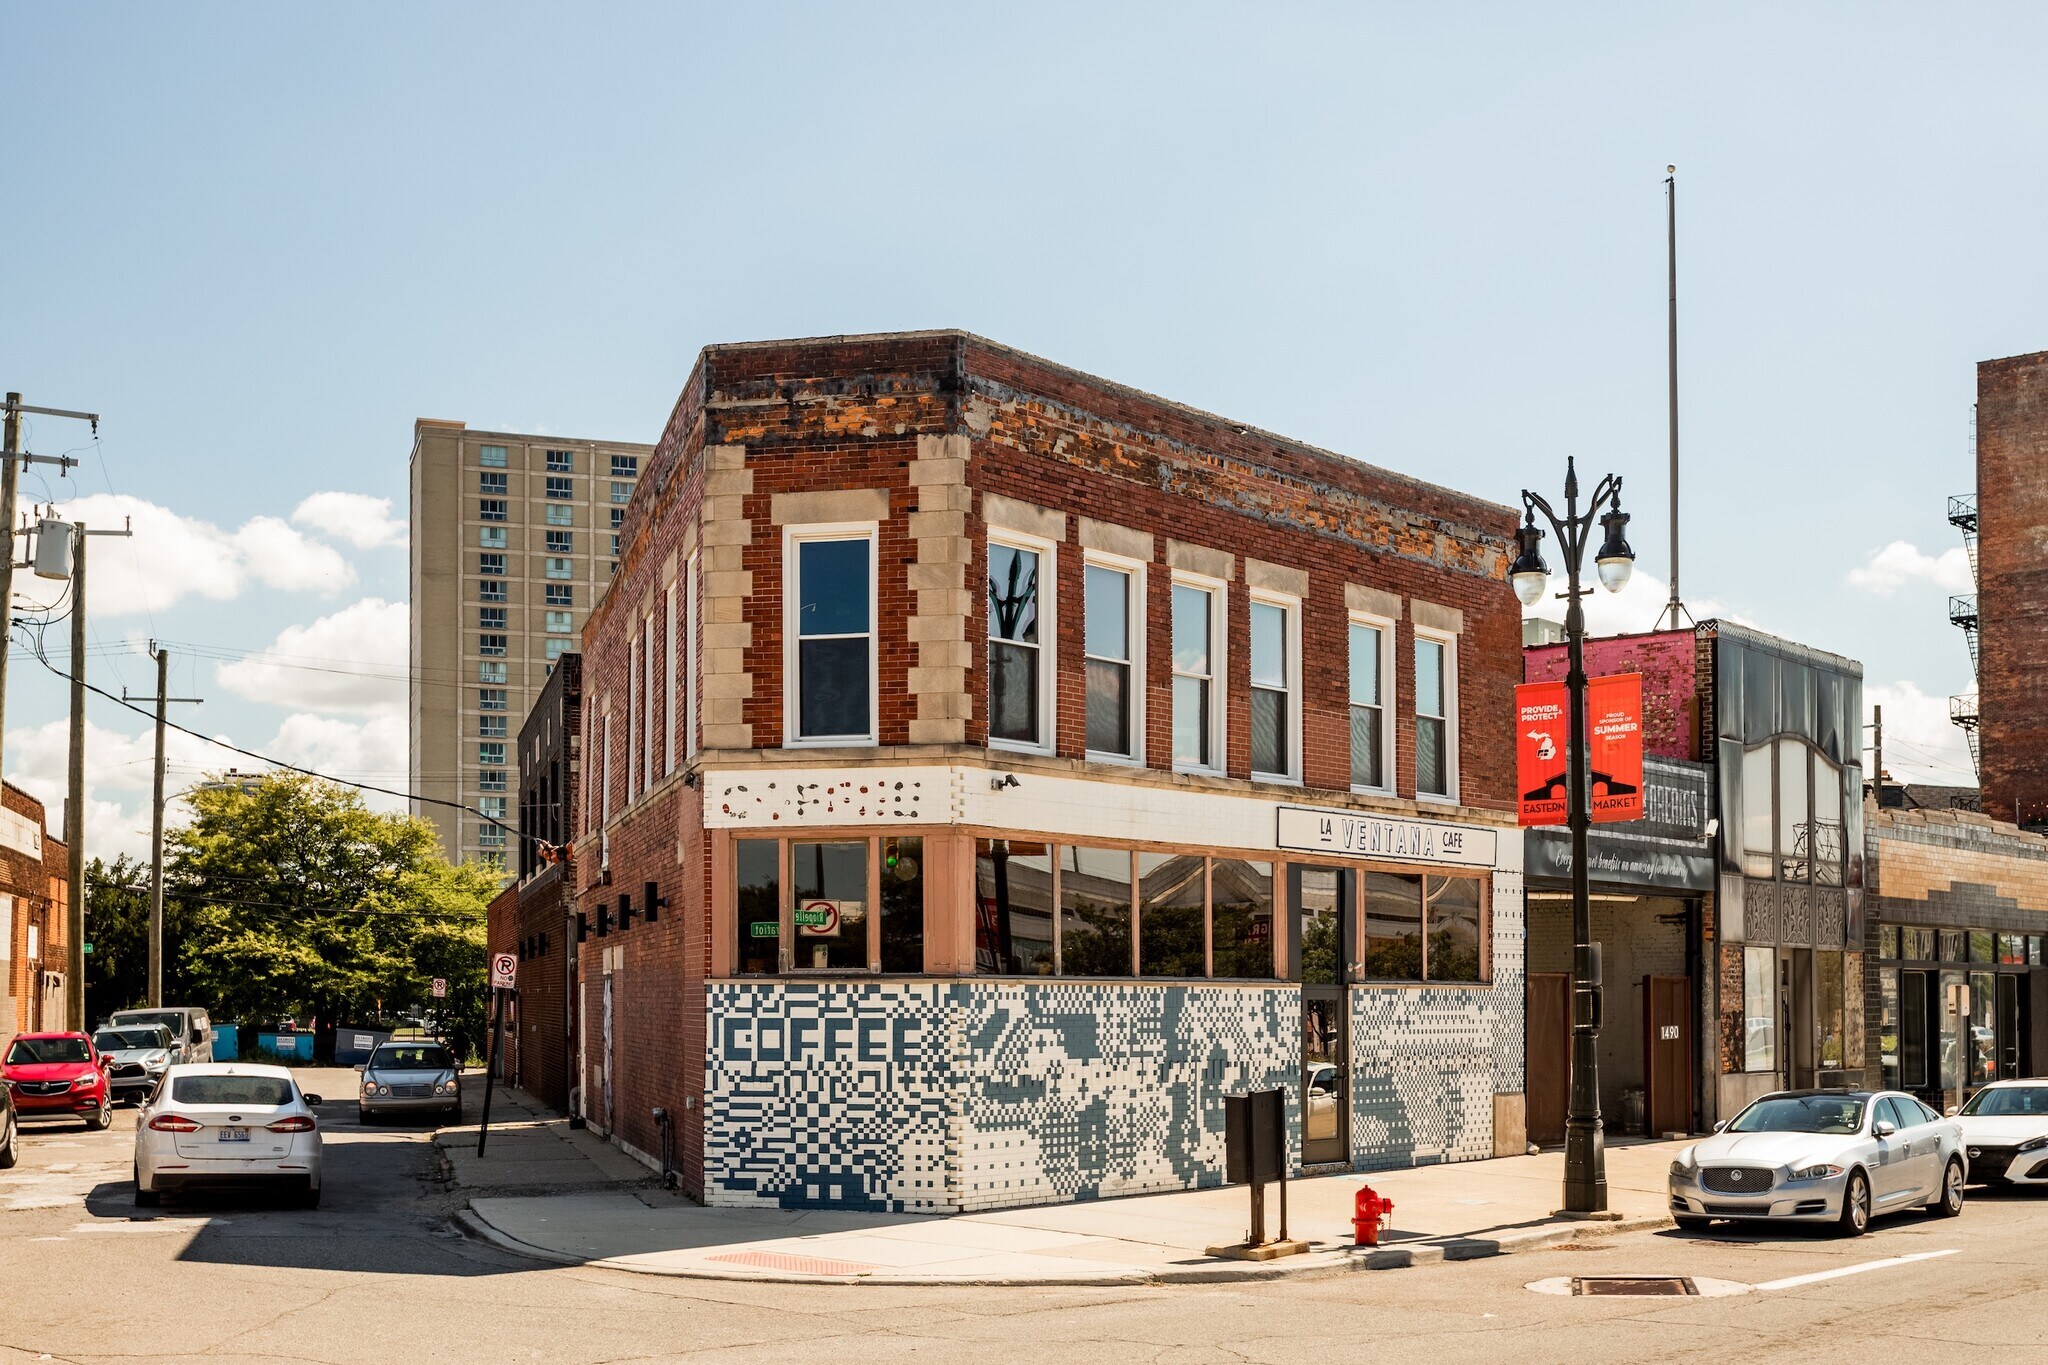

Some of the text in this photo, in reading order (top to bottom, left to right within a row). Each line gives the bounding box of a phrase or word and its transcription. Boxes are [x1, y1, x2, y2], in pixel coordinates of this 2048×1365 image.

[1521, 705, 1558, 714] PROVIDE
[1521, 713, 1558, 722] PROTECT
[1594, 723, 1638, 735] SUMMER
[1523, 802, 1566, 814] EASTERN
[1593, 797, 1637, 811] MARKET
[1650, 784, 1698, 828] DREAMS
[1320, 818, 1463, 857] LA VENTANA CAFE
[1597, 851, 1621, 872] benefits
[1621, 860, 1629, 871] an
[1629, 859, 1654, 880] amazing
[1654, 858, 1670, 876] local
[1669, 861, 1689, 883] charity
[1661, 1025, 1679, 1039] 1490
[724, 1018, 922, 1061] COFFEE
